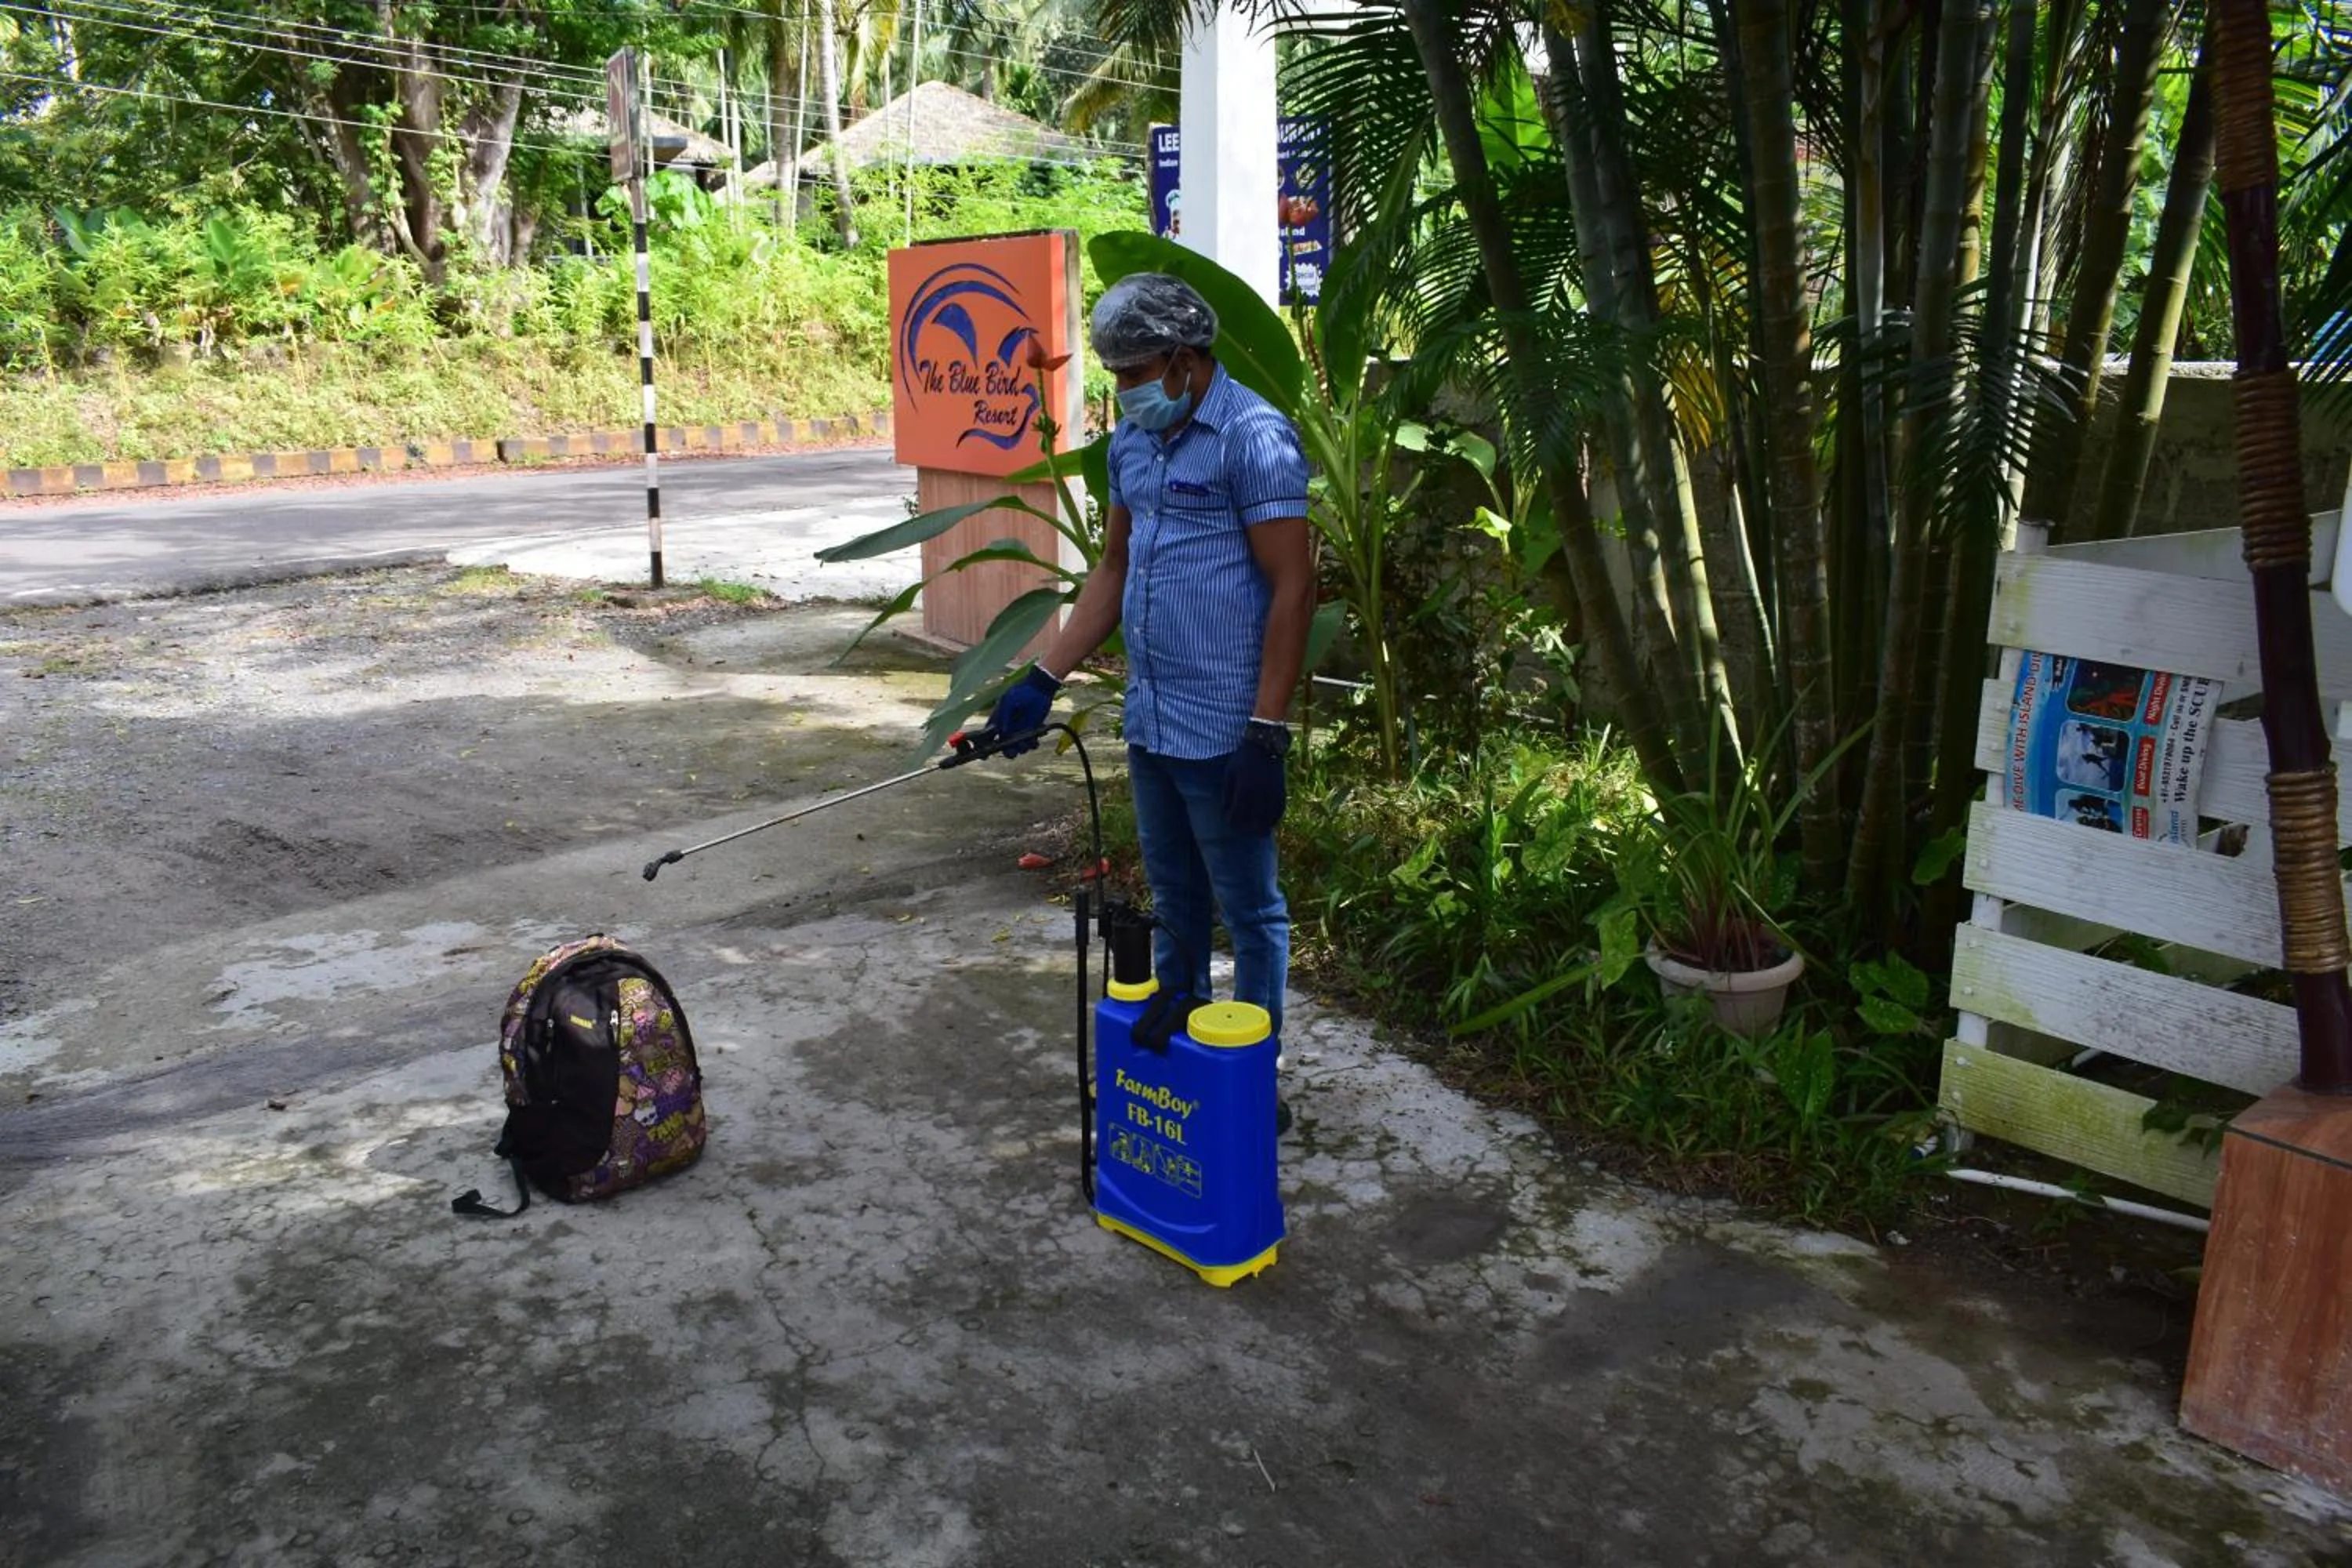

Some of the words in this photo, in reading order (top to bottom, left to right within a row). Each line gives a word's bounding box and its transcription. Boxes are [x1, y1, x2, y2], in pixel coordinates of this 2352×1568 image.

[920, 360, 944, 394] The
[949, 361, 979, 395] Blue
[985, 361, 1022, 396] Bird
[974, 400, 1018, 426] Resort
[2020, 676, 2037, 725] ISLAND
[2014, 725, 2028, 760] WITH
[2183, 720, 2198, 744] the
[2180, 746, 2194, 763] up
[2173, 768, 2188, 803] Wake
[1128, 1102, 1187, 1145] FB-16L
